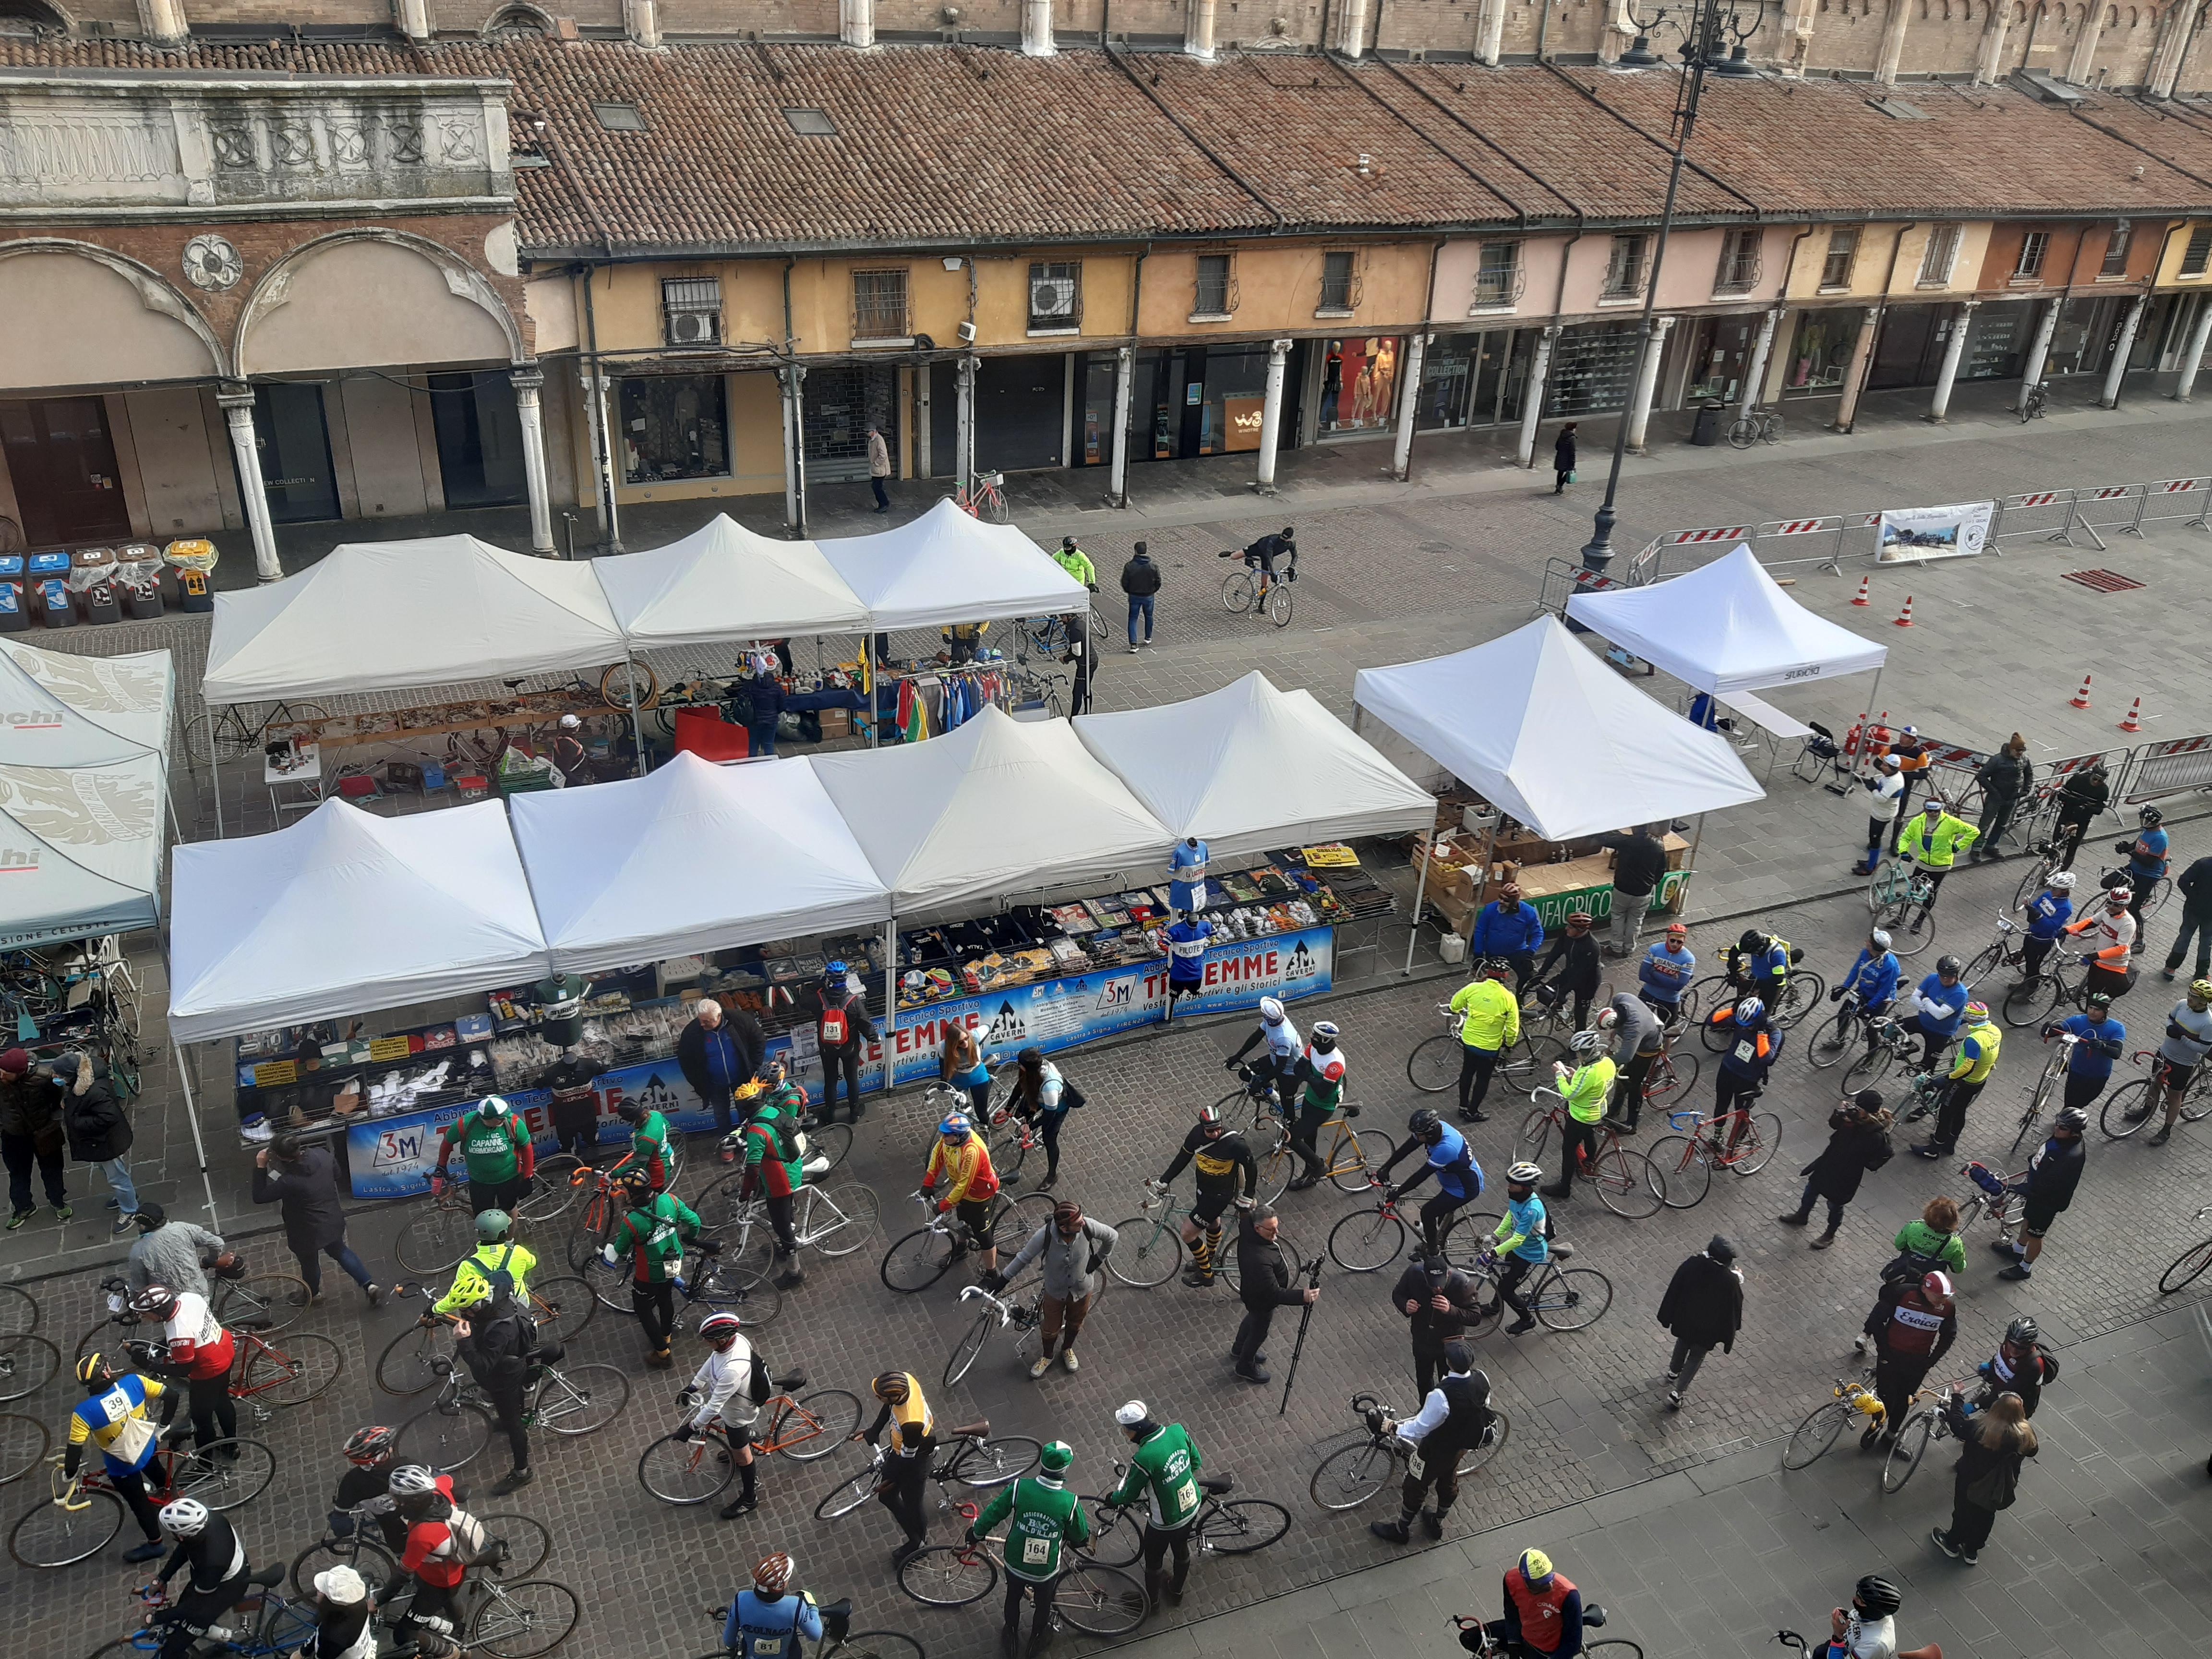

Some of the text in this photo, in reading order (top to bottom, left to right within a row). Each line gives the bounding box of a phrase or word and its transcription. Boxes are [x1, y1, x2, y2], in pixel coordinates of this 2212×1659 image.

[1427, 364, 1467, 375] COLLECTION
[51, 920, 111, 936] CELESTE
[1209, 939, 1279, 959] Tecnico Sportivo
[1286, 950, 1315, 971] 3M
[1204, 950, 1278, 986] EMME
[1286, 965, 1316, 977] CAVERNI
[1034, 987, 1043, 996] 3M
[1106, 981, 1129, 1004] 3M
[1185, 987, 1223, 1004] Sportivi
[1234, 982, 1247, 997] gli
[1250, 977, 1281, 991] Storici
[1036, 998, 1066, 1008] Abbigliamento
[898, 999, 980, 1025] Tecnico Sportivo
[1111, 1006, 1128, 1015] 1974
[991, 1012, 1025, 1034] 3M
[1066, 1033, 1086, 1042] Lastra
[1092, 1025, 1111, 1035] Signa
[1117, 1017, 1145, 1029] FIRENZE
[990, 1028, 1025, 1041] CAVERNI
[1742, 1045, 1750, 1054] 42
[383, 1133, 418, 1159] 3M
[469, 1145, 509, 1154] MOBIMORGANTI
[471, 1138, 504, 1148] CAPANNE
[382, 1162, 420, 1177] dal 1974
[363, 1184, 391, 1193] Lastra
[400, 1180, 426, 1192] Signa
[1899, 1311, 1939, 1328] Eroica
[108, 1396, 123, 1410] 39
[1412, 1455, 1422, 1471] 136
[1180, 1488, 1194, 1501] 165
[1023, 1511, 1058, 1527] ASSICURAZIONI
[1028, 1518, 1050, 1531] B&C
[1027, 1543, 1046, 1555] 164
[742, 1624, 793, 1635] COLNAGO
